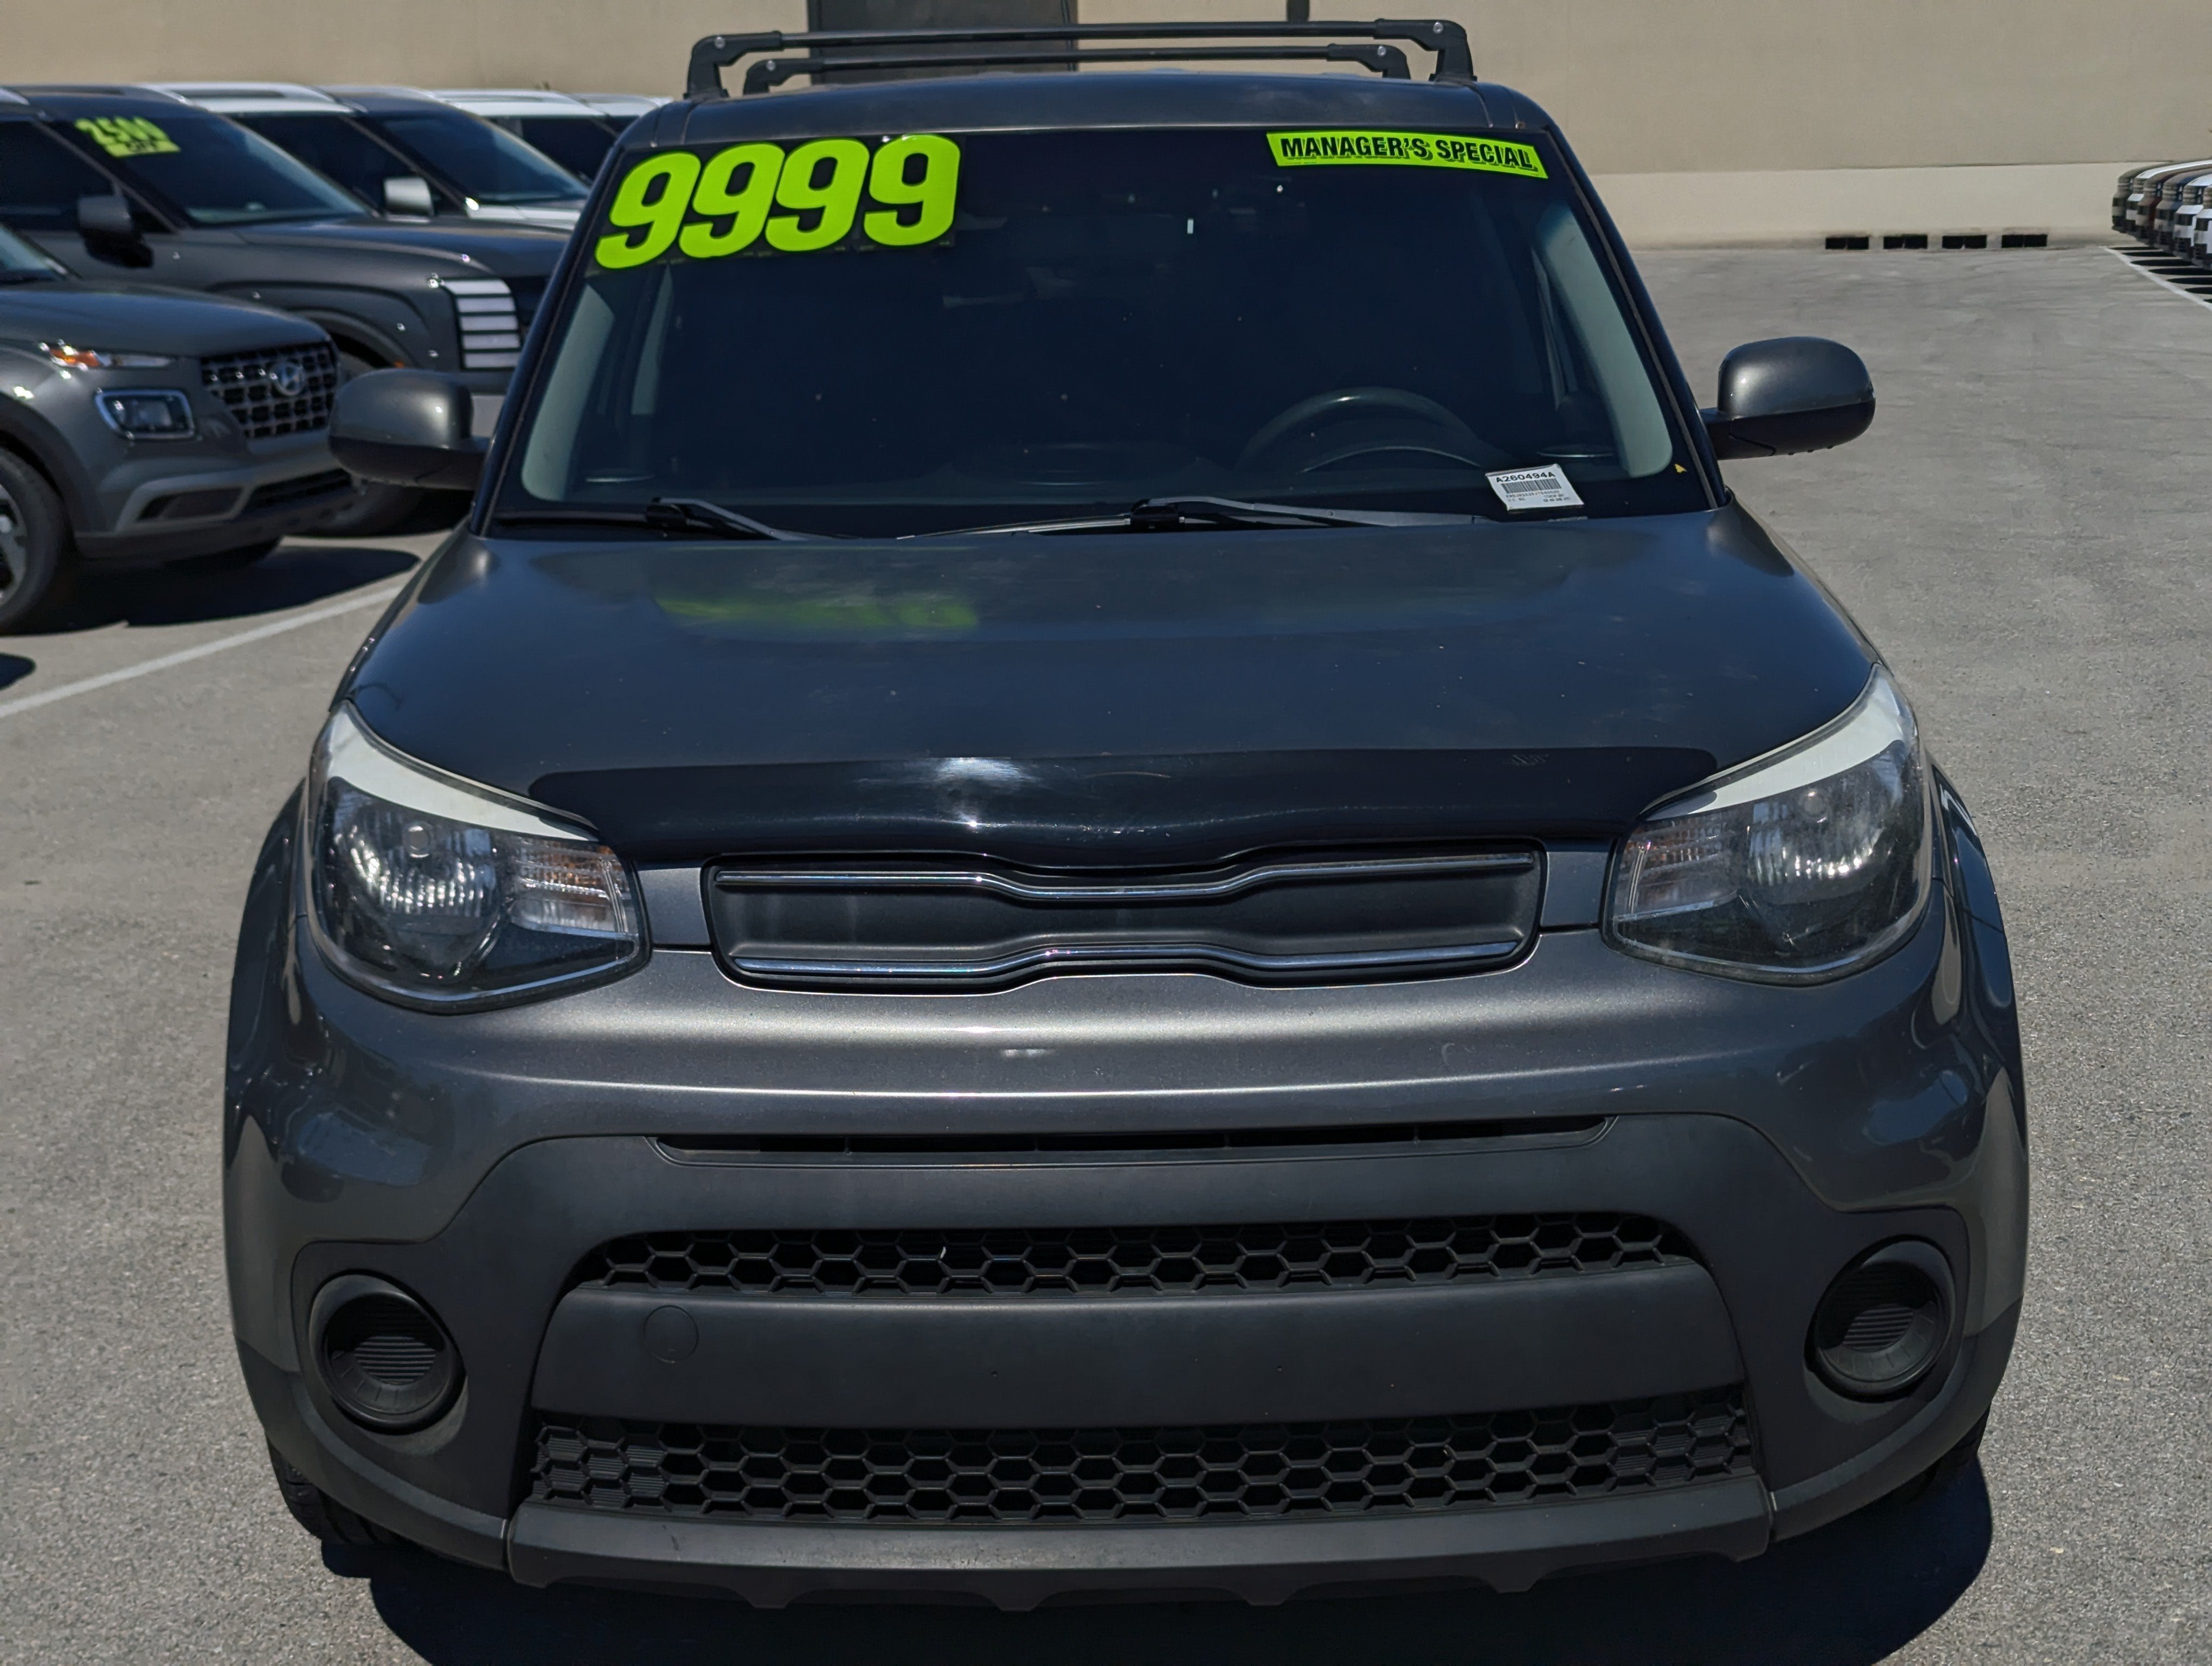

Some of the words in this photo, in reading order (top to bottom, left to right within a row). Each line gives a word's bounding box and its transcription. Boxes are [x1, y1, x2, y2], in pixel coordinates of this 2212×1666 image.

[1280, 136, 1431, 161] MANAGER'S
[1436, 139, 1536, 171] SPECIAL
[595, 133, 961, 269] 9999
